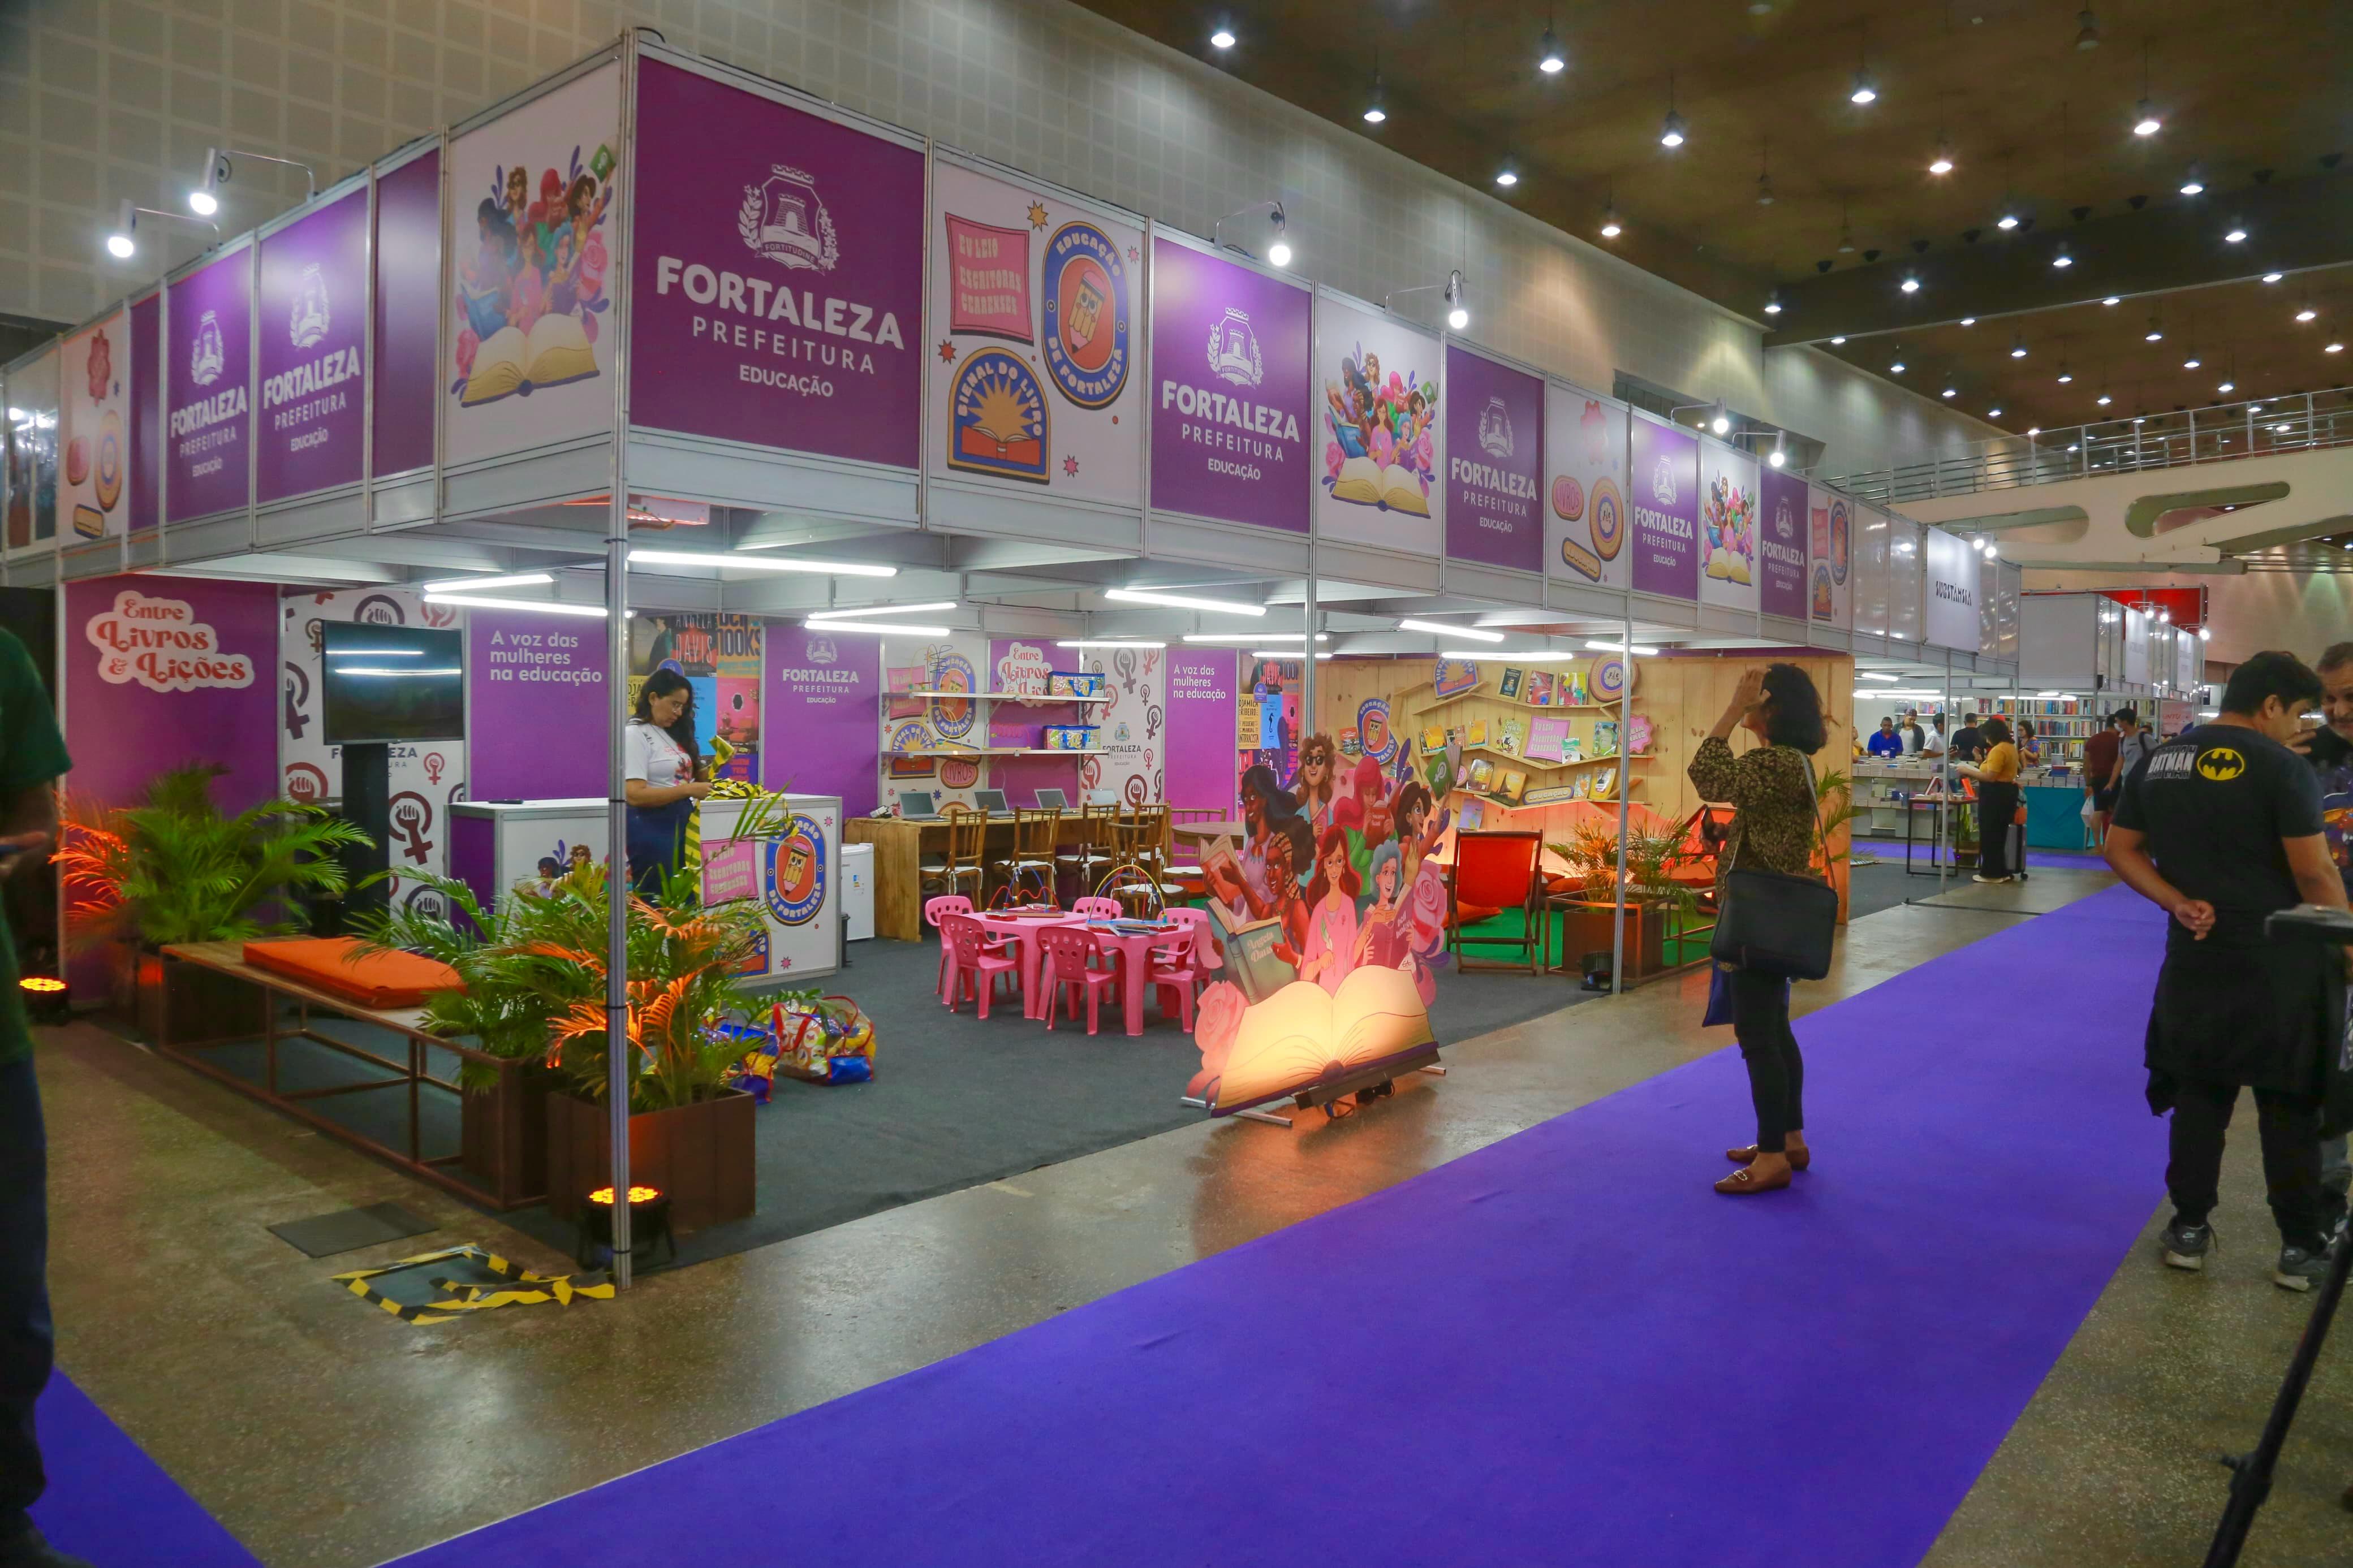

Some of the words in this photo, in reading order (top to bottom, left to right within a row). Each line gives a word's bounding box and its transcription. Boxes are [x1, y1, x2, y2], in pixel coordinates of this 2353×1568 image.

[764, 243, 815, 263] FORTITUDINE
[959, 234, 972, 258] EU
[975, 237, 998, 258] LEIO
[1055, 232, 1121, 277] EDUCAÇÃO
[959, 265, 1022, 293] ESCRITORAS
[657, 256, 904, 349] FORTALEZA
[693, 316, 874, 374] PREFEITURA
[264, 346, 361, 409] FORTALEZA
[1049, 336, 1059, 364] DE
[1059, 347, 1123, 395] FORTALEZA
[739, 365, 834, 397] EDUCAÇÃO
[171, 386, 247, 438] FORTALEZA
[275, 392, 346, 430] PREFEITURA
[958, 362, 994, 417] BIENAL
[998, 361, 1018, 380] DO
[1020, 378, 1042, 436] LIVRO
[1162, 380, 1300, 442] FORTALEZA
[180, 426, 237, 458] PREFEITURA
[291, 427, 329, 451] EDUCAÇÃO
[1182, 423, 1283, 462] PREFEITURA
[1208, 457, 1261, 481] EDUCAÇÃO
[1451, 457, 1537, 501] FORTALEZA
[1464, 490, 1527, 517] PREFEITURA
[1557, 483, 1579, 509] LIVROS
[1480, 517, 1512, 533] EDUCAÇÃO
[1635, 506, 1693, 539] FORTALEZA
[1643, 533, 1686, 553] PREFEITURA
[1762, 540, 1804, 567] FORTALEZA
[1653, 554, 1676, 567] EDUCAÇÃO
[1768, 563, 1799, 578] PREFEITURA
[123, 599, 184, 620] Entre
[96, 620, 209, 651] Livros
[491, 630, 505, 645] A
[510, 634, 541, 647] voz
[548, 632, 578, 648] das
[676, 634, 713, 663] DAVIS
[490, 646, 571, 666] mulheres
[1013, 647, 1039, 660] Entre
[135, 651, 245, 684] Lições
[490, 668, 512, 682] na
[519, 667, 602, 686] educação
[782, 669, 859, 683] FORTALEZA
[1002, 662, 1048, 681] Livros
[1174, 664, 1180, 674] A
[1200, 664, 1214, 675] das
[1173, 676, 1211, 687] mulheres
[1187, 688, 1226, 702] educação
[2148, 753, 2195, 774] BATMAN
[769, 889, 779, 905] DE
[777, 882, 821, 917] FORTALEZA
